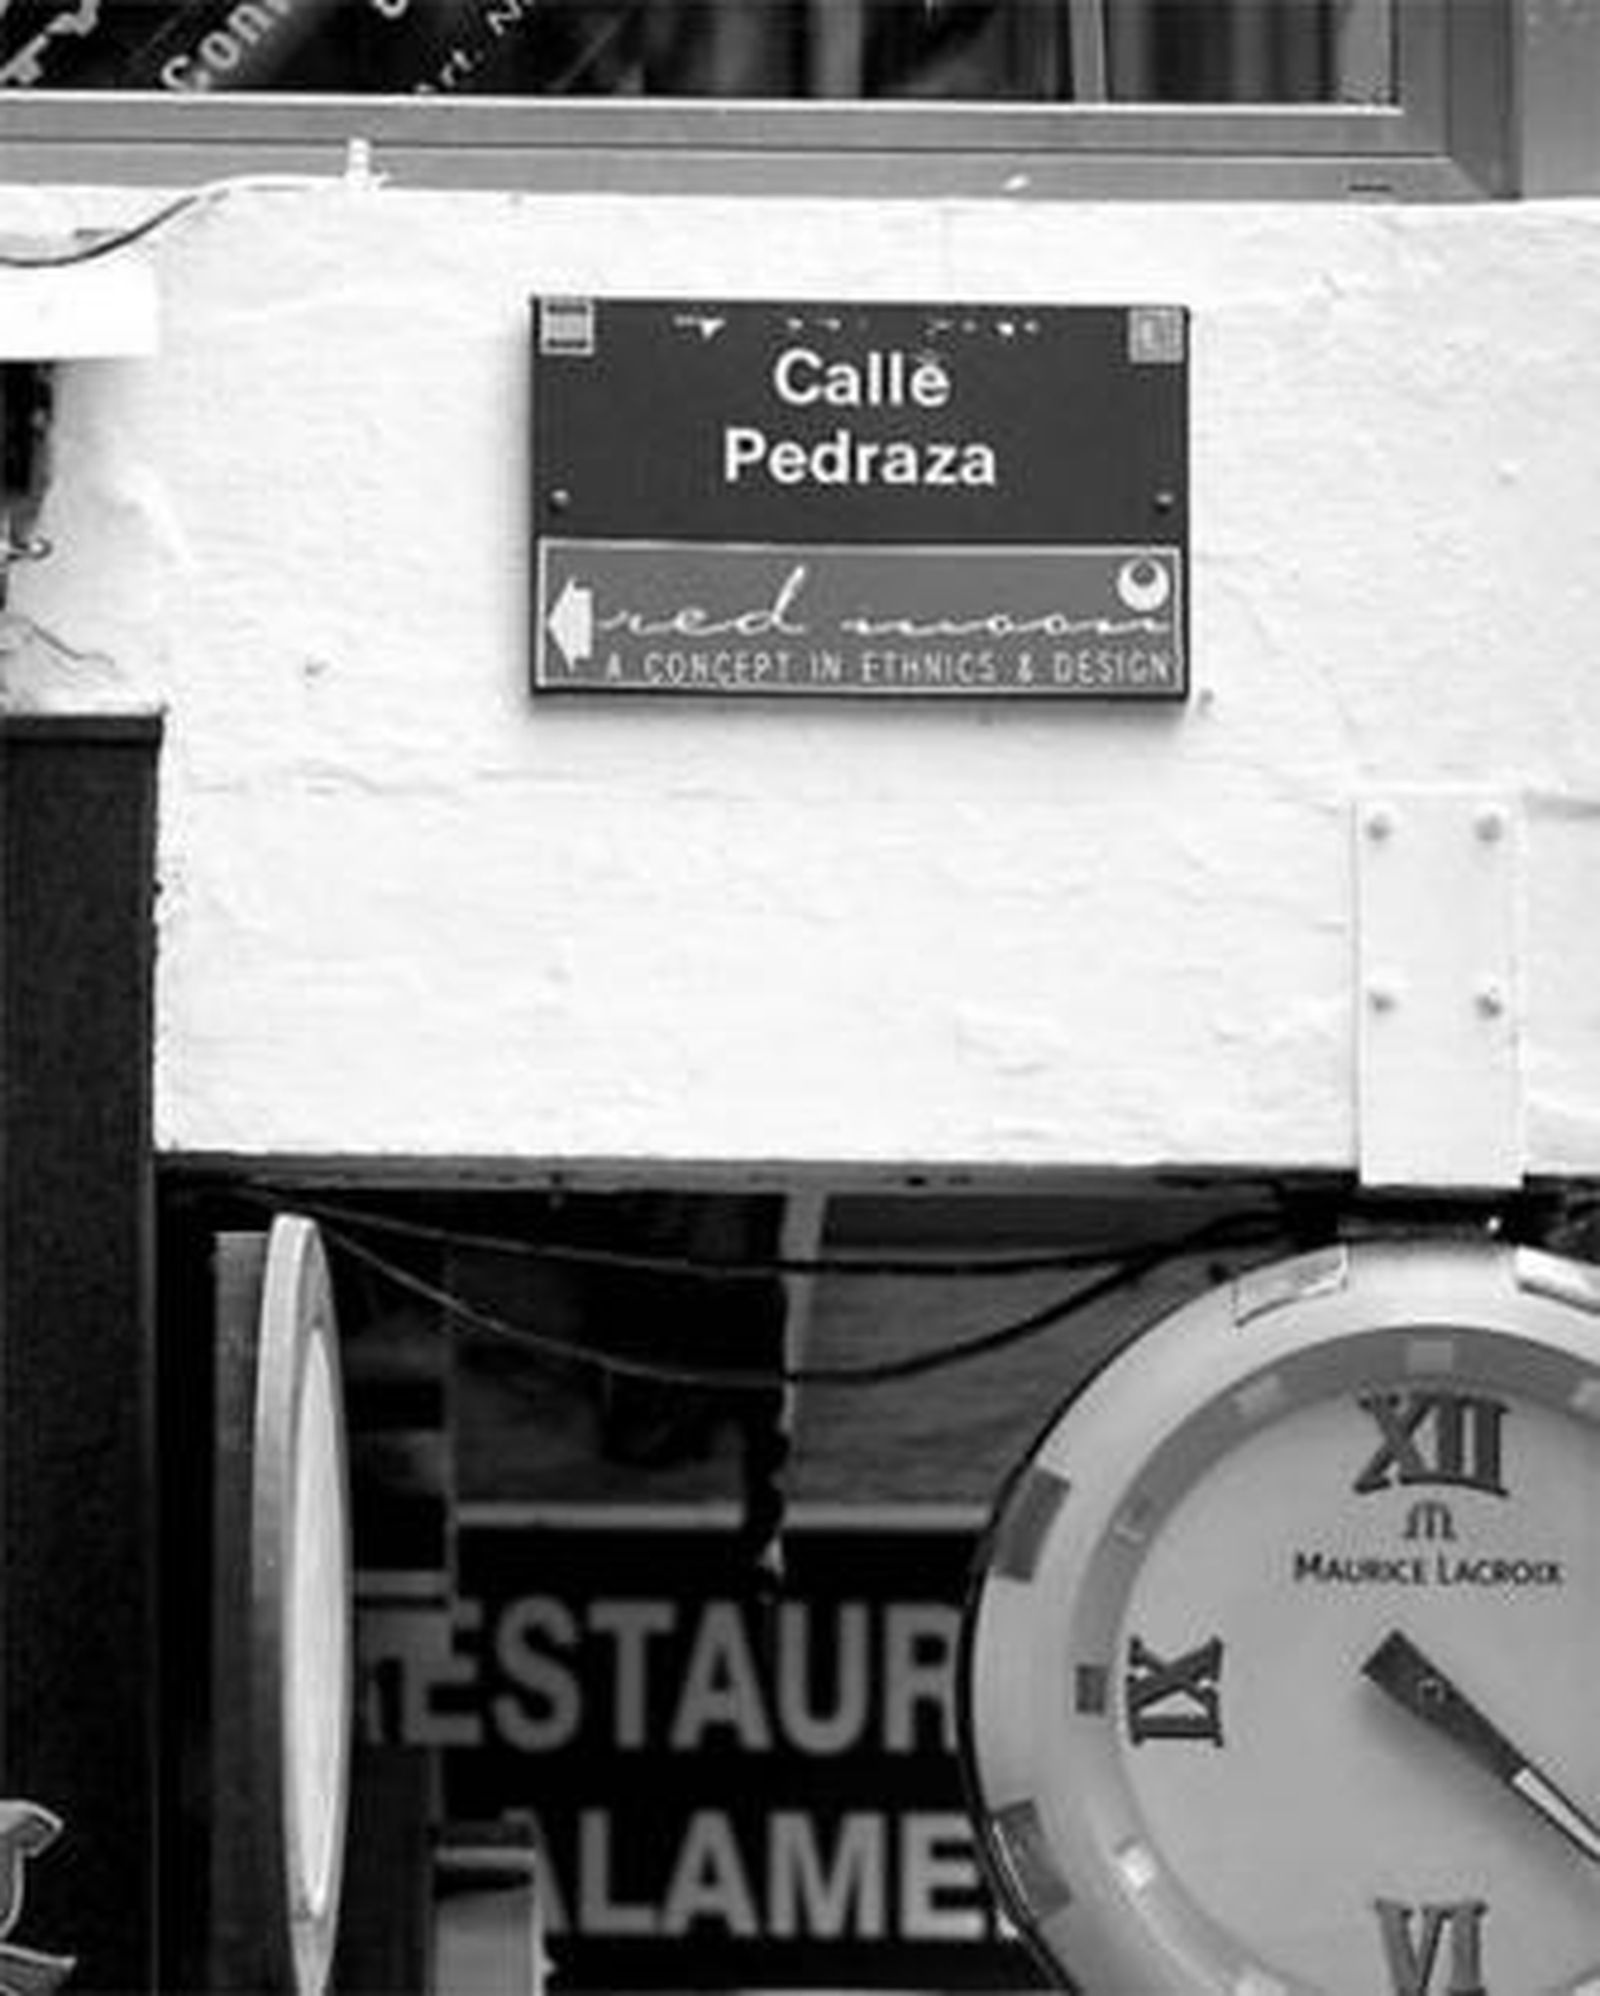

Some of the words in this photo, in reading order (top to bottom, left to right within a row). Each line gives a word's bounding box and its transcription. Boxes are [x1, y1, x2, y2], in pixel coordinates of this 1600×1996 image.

[723, 427, 997, 486] Pedraza
[600, 565, 806, 637] red
[606, 652, 622, 680] A
[644, 651, 789, 687] CONCEPT
[811, 653, 842, 682] IN
[861, 652, 997, 684] ETHNICS
[1053, 652, 1174, 685] DESIGN
[1354, 1392, 1511, 1498] XII
